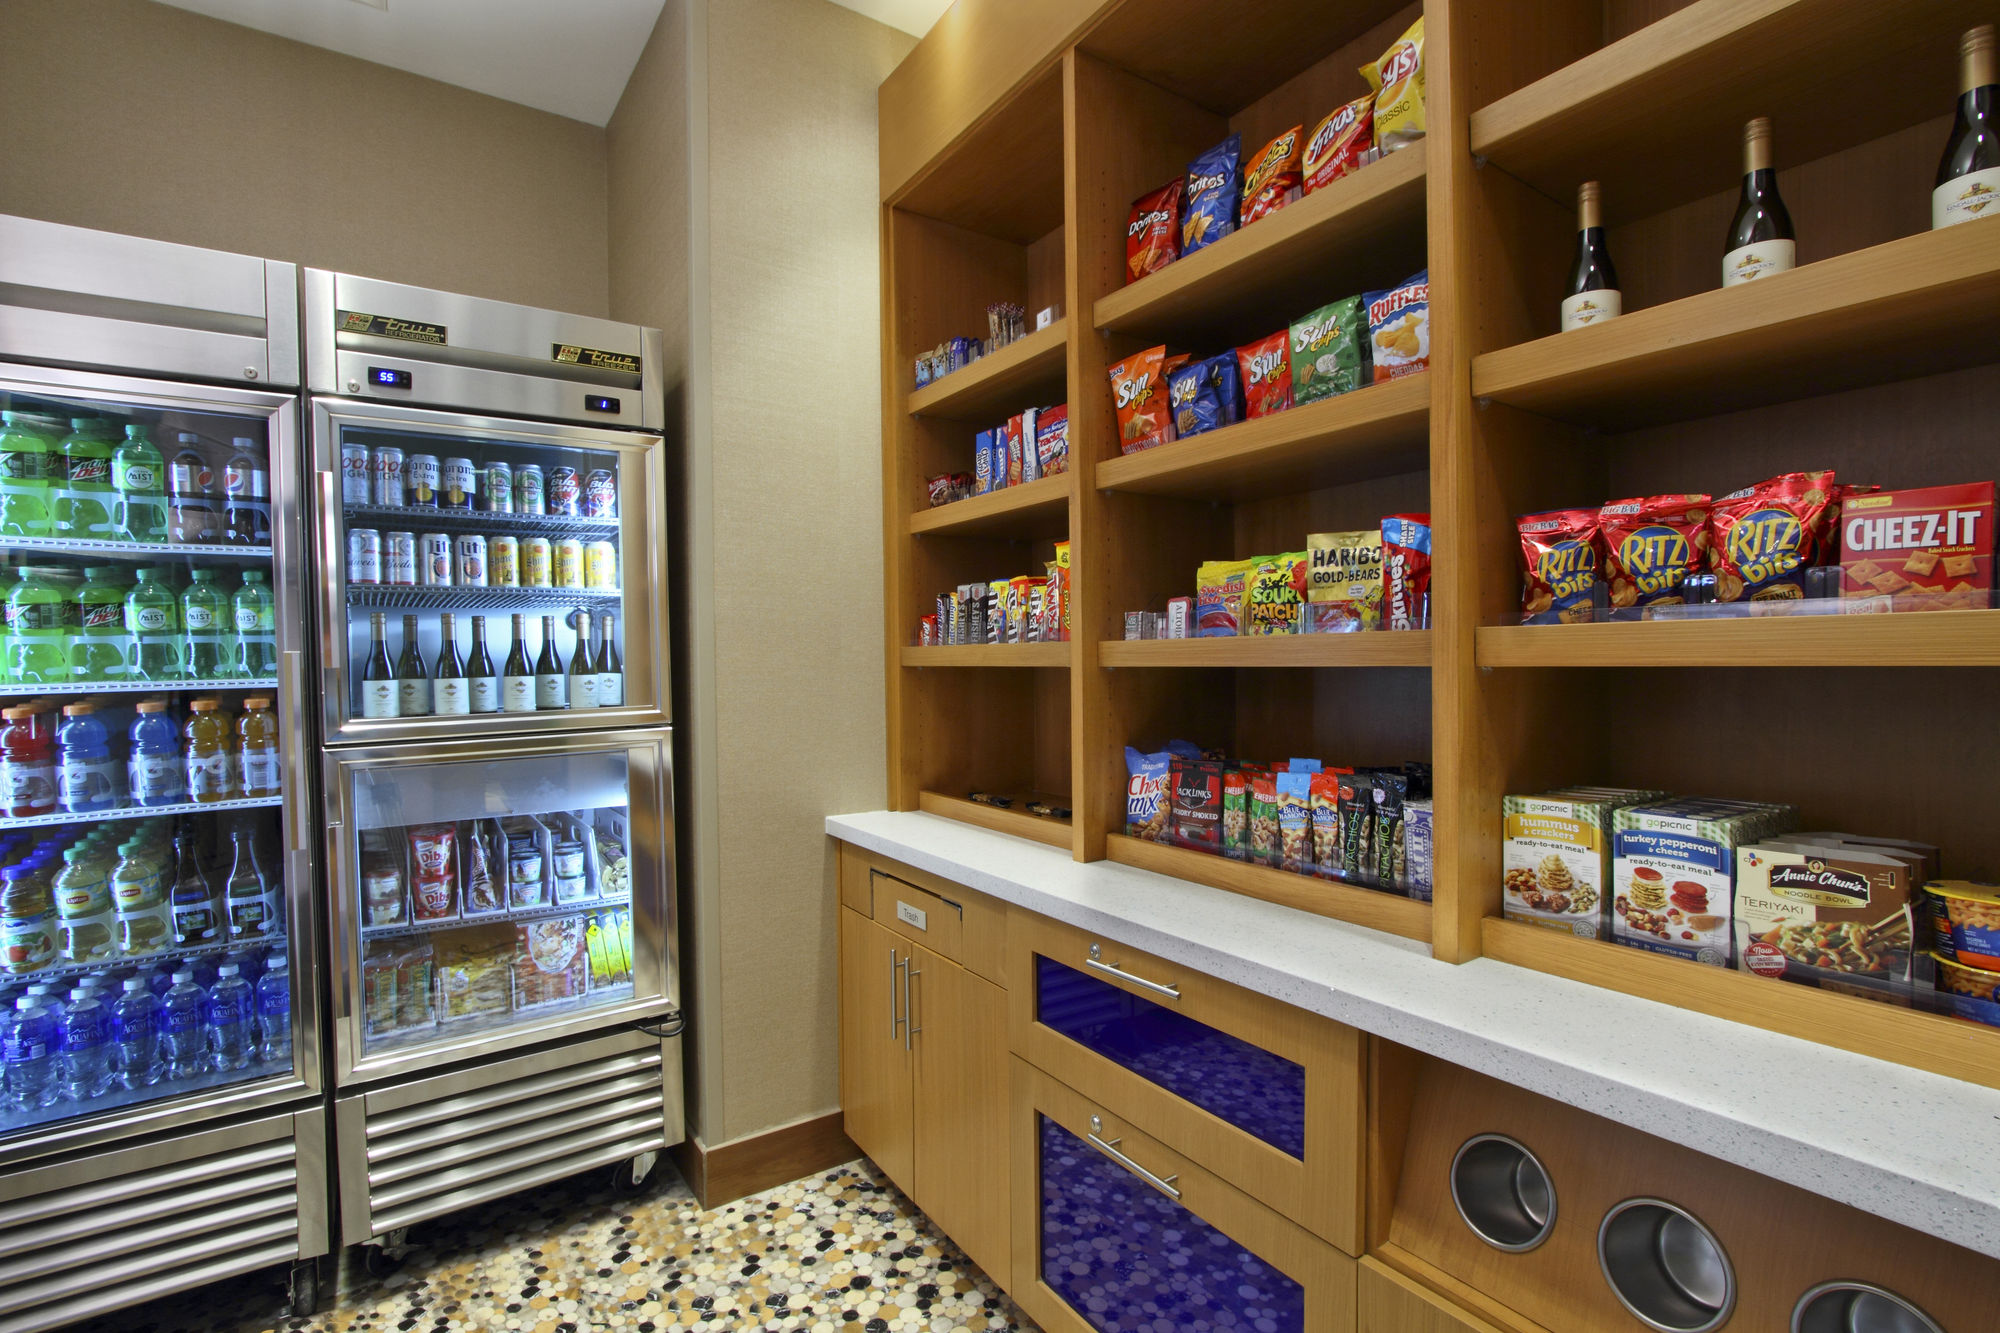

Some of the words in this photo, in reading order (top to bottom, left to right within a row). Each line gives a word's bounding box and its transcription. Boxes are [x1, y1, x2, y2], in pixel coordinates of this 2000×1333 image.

[1307, 105, 1355, 165] Fritos
[1316, 148, 1349, 181] ORIGINAL
[1128, 210, 1169, 236] Doritos
[385, 329, 440, 342] REFRIGERATOR
[1294, 315, 1337, 353] Sun
[1249, 348, 1284, 384] Sun
[1389, 362, 1425, 377] CHEDDAR
[1117, 372, 1150, 409] Sun
[550, 479, 576, 487] BUD
[590, 480, 614, 489] BUD
[1601, 505, 1620, 515] BIG
[1620, 503, 1640, 514] BAG
[1399, 519, 1408, 548] SHARE
[1407, 526, 1416, 544] SIZE
[1520, 523, 1539, 532] BIG
[1540, 520, 1559, 529] BAG
[1846, 510, 1982, 552] CHEEZ-IT
[1729, 517, 1799, 563] RITZ
[1313, 546, 1383, 568] HARIBO
[1538, 541, 1591, 584] RITZ
[1623, 535, 1685, 576] RITZ
[1313, 568, 1380, 584] GOLD-BEARS
[1741, 552, 1799, 583] bits
[1200, 581, 1246, 595] Swedish
[1551, 572, 1594, 599] bits
[1636, 567, 1687, 595] bits
[1046, 573, 1059, 626] TWIX
[1251, 586, 1296, 603] SOUR
[1251, 603, 1298, 620] PATCH
[971, 602, 980, 642] ERSHEY'S
[1128, 775, 1164, 796] Chex
[1192, 788, 1212, 799] LINK'S
[1129, 793, 1158, 815] mix
[1283, 806, 1300, 815] BLUE
[1316, 807, 1330, 816] BLUE
[1530, 803, 1568, 813] gopicnic
[1192, 811, 1219, 820] SMOKED
[1519, 816, 1580, 833] hummus
[1646, 819, 1692, 831] gopicnic
[1345, 813, 1360, 873] STACHIOS
[1530, 828, 1575, 841] crackers
[1516, 840, 1563, 850] ready-to-eat
[1565, 845, 1585, 854] meal
[1624, 834, 1658, 846] turkey
[1659, 837, 1717, 855] pepperoni
[1655, 847, 1689, 858] cheese
[1629, 858, 1686, 870] ready-to-eat
[1688, 866, 1712, 877] meal
[1771, 868, 1816, 884] Annie
[1820, 871, 1867, 892] Chun's
[1741, 895, 1804, 915] TERIYAKI
[1784, 889, 1822, 899] NOODLE
[1825, 896, 1854, 905] BOWL
[903, 907, 919, 923] Trash
